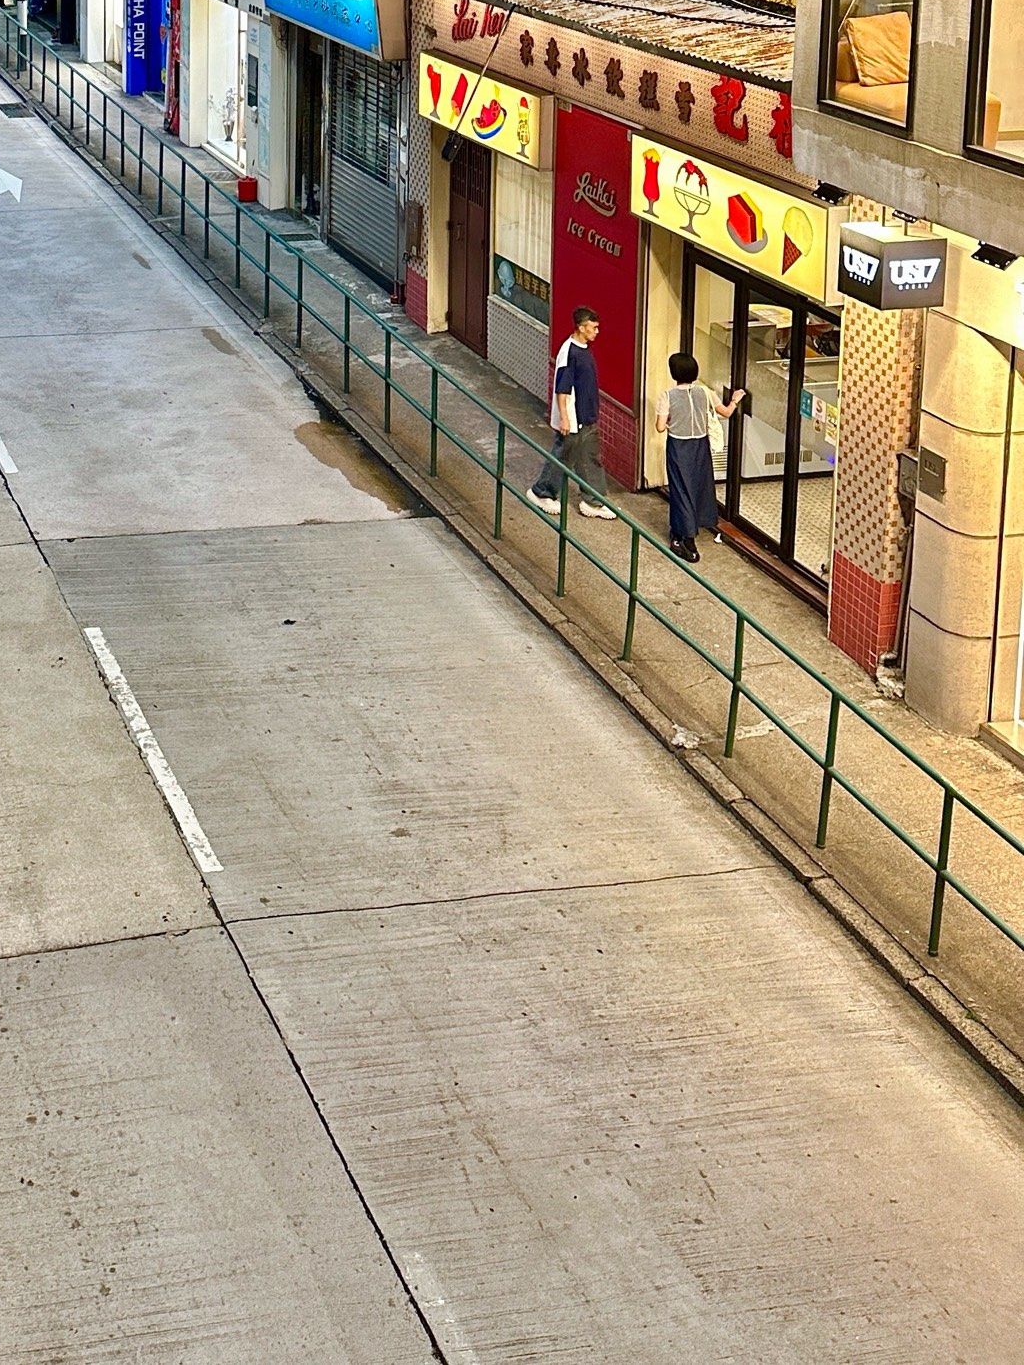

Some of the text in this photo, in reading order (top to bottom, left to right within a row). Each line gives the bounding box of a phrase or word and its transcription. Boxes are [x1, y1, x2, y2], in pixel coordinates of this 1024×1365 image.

[133, 22, 145, 59] POINT
[567, 218, 622, 257] Ice Cream
